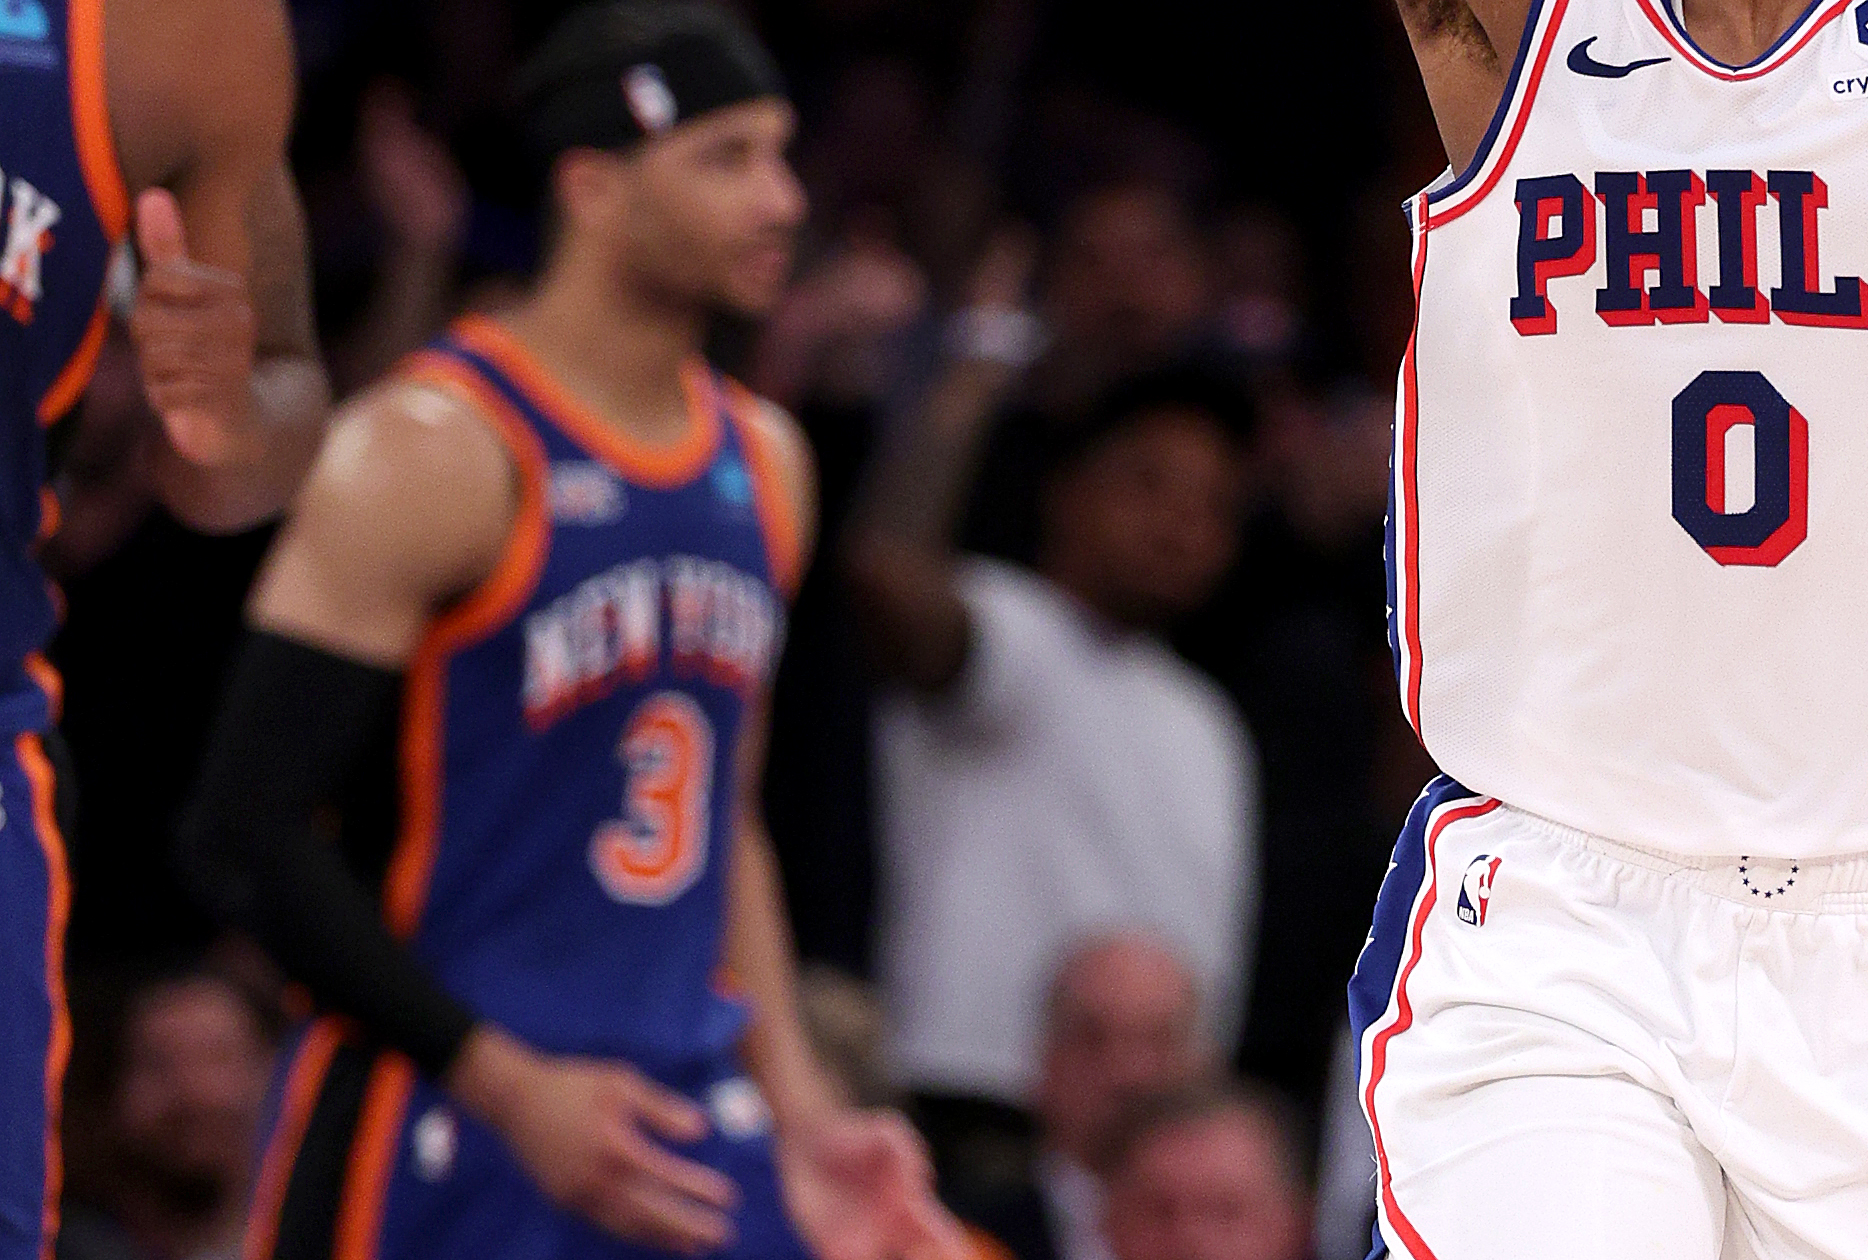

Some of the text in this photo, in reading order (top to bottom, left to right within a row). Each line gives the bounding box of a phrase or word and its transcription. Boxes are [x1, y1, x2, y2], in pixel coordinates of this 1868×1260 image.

[0, 165, 62, 326] K
[1671, 370, 1809, 567] 0
[590, 690, 716, 906] 3
[1459, 906, 1474, 923] NBA
